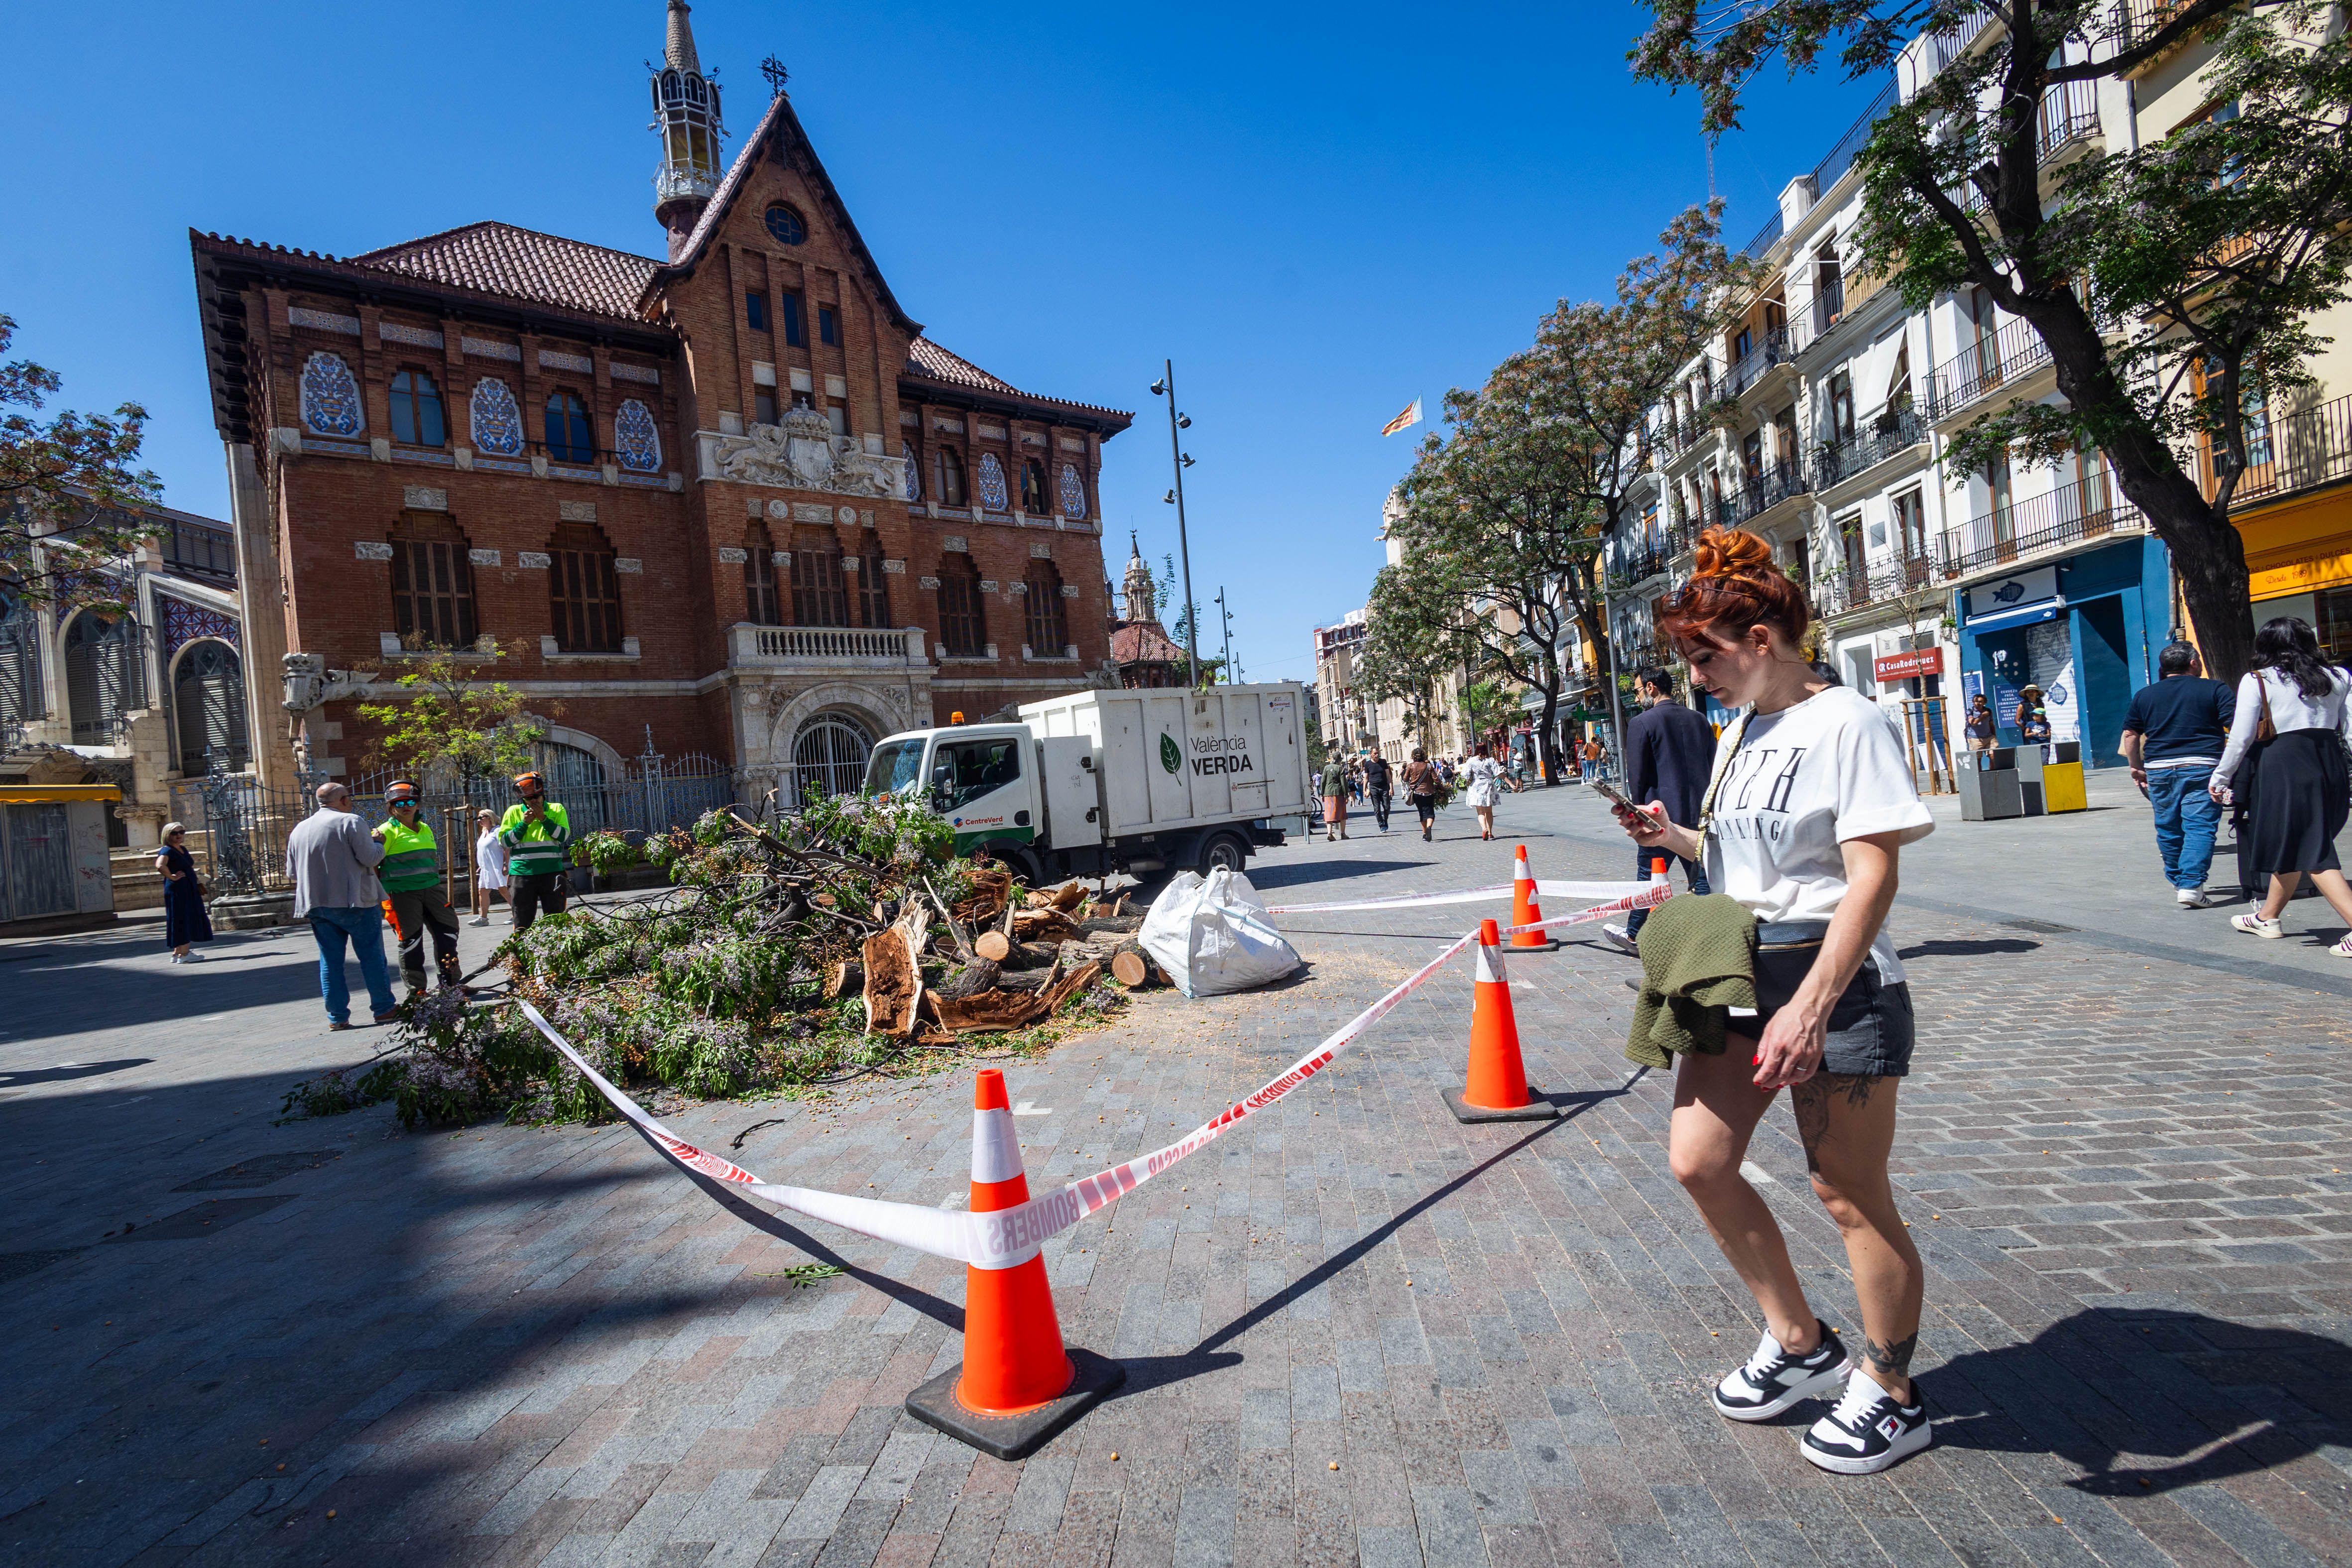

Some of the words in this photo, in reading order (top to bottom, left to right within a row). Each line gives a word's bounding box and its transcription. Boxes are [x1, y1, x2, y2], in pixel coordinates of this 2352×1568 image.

[2265, 555, 2314, 571] CHOCOLATES
[2320, 547, 2351, 560] DULCES
[2265, 574, 2286, 584] Desde
[2292, 569, 2307, 580] 1989
[1190, 734, 1246, 753] València
[1191, 754, 1253, 776] VERDA
[965, 816, 1003, 825] CentreVerd
